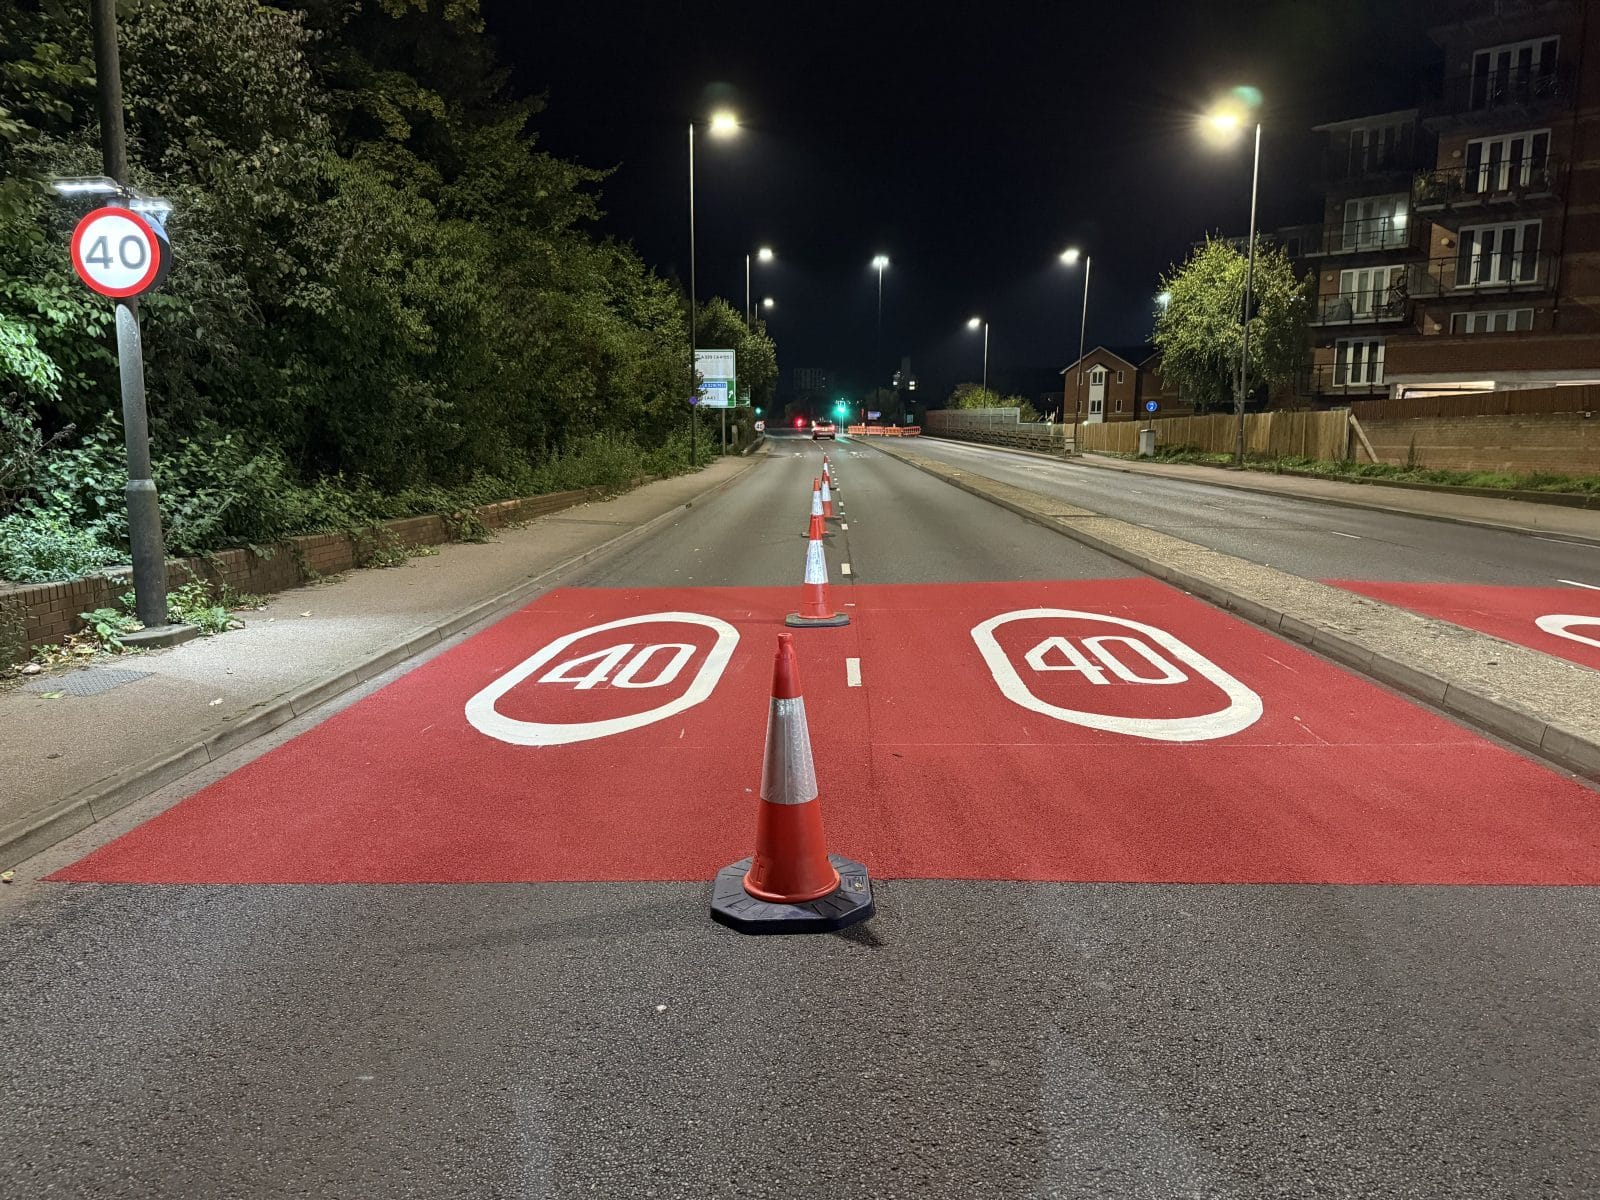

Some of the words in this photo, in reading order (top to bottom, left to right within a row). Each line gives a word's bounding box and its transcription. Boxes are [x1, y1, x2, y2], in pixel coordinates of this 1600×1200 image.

[86, 235, 146, 269] 40
[537, 643, 696, 689] 40
[1025, 636, 1189, 684] 40
